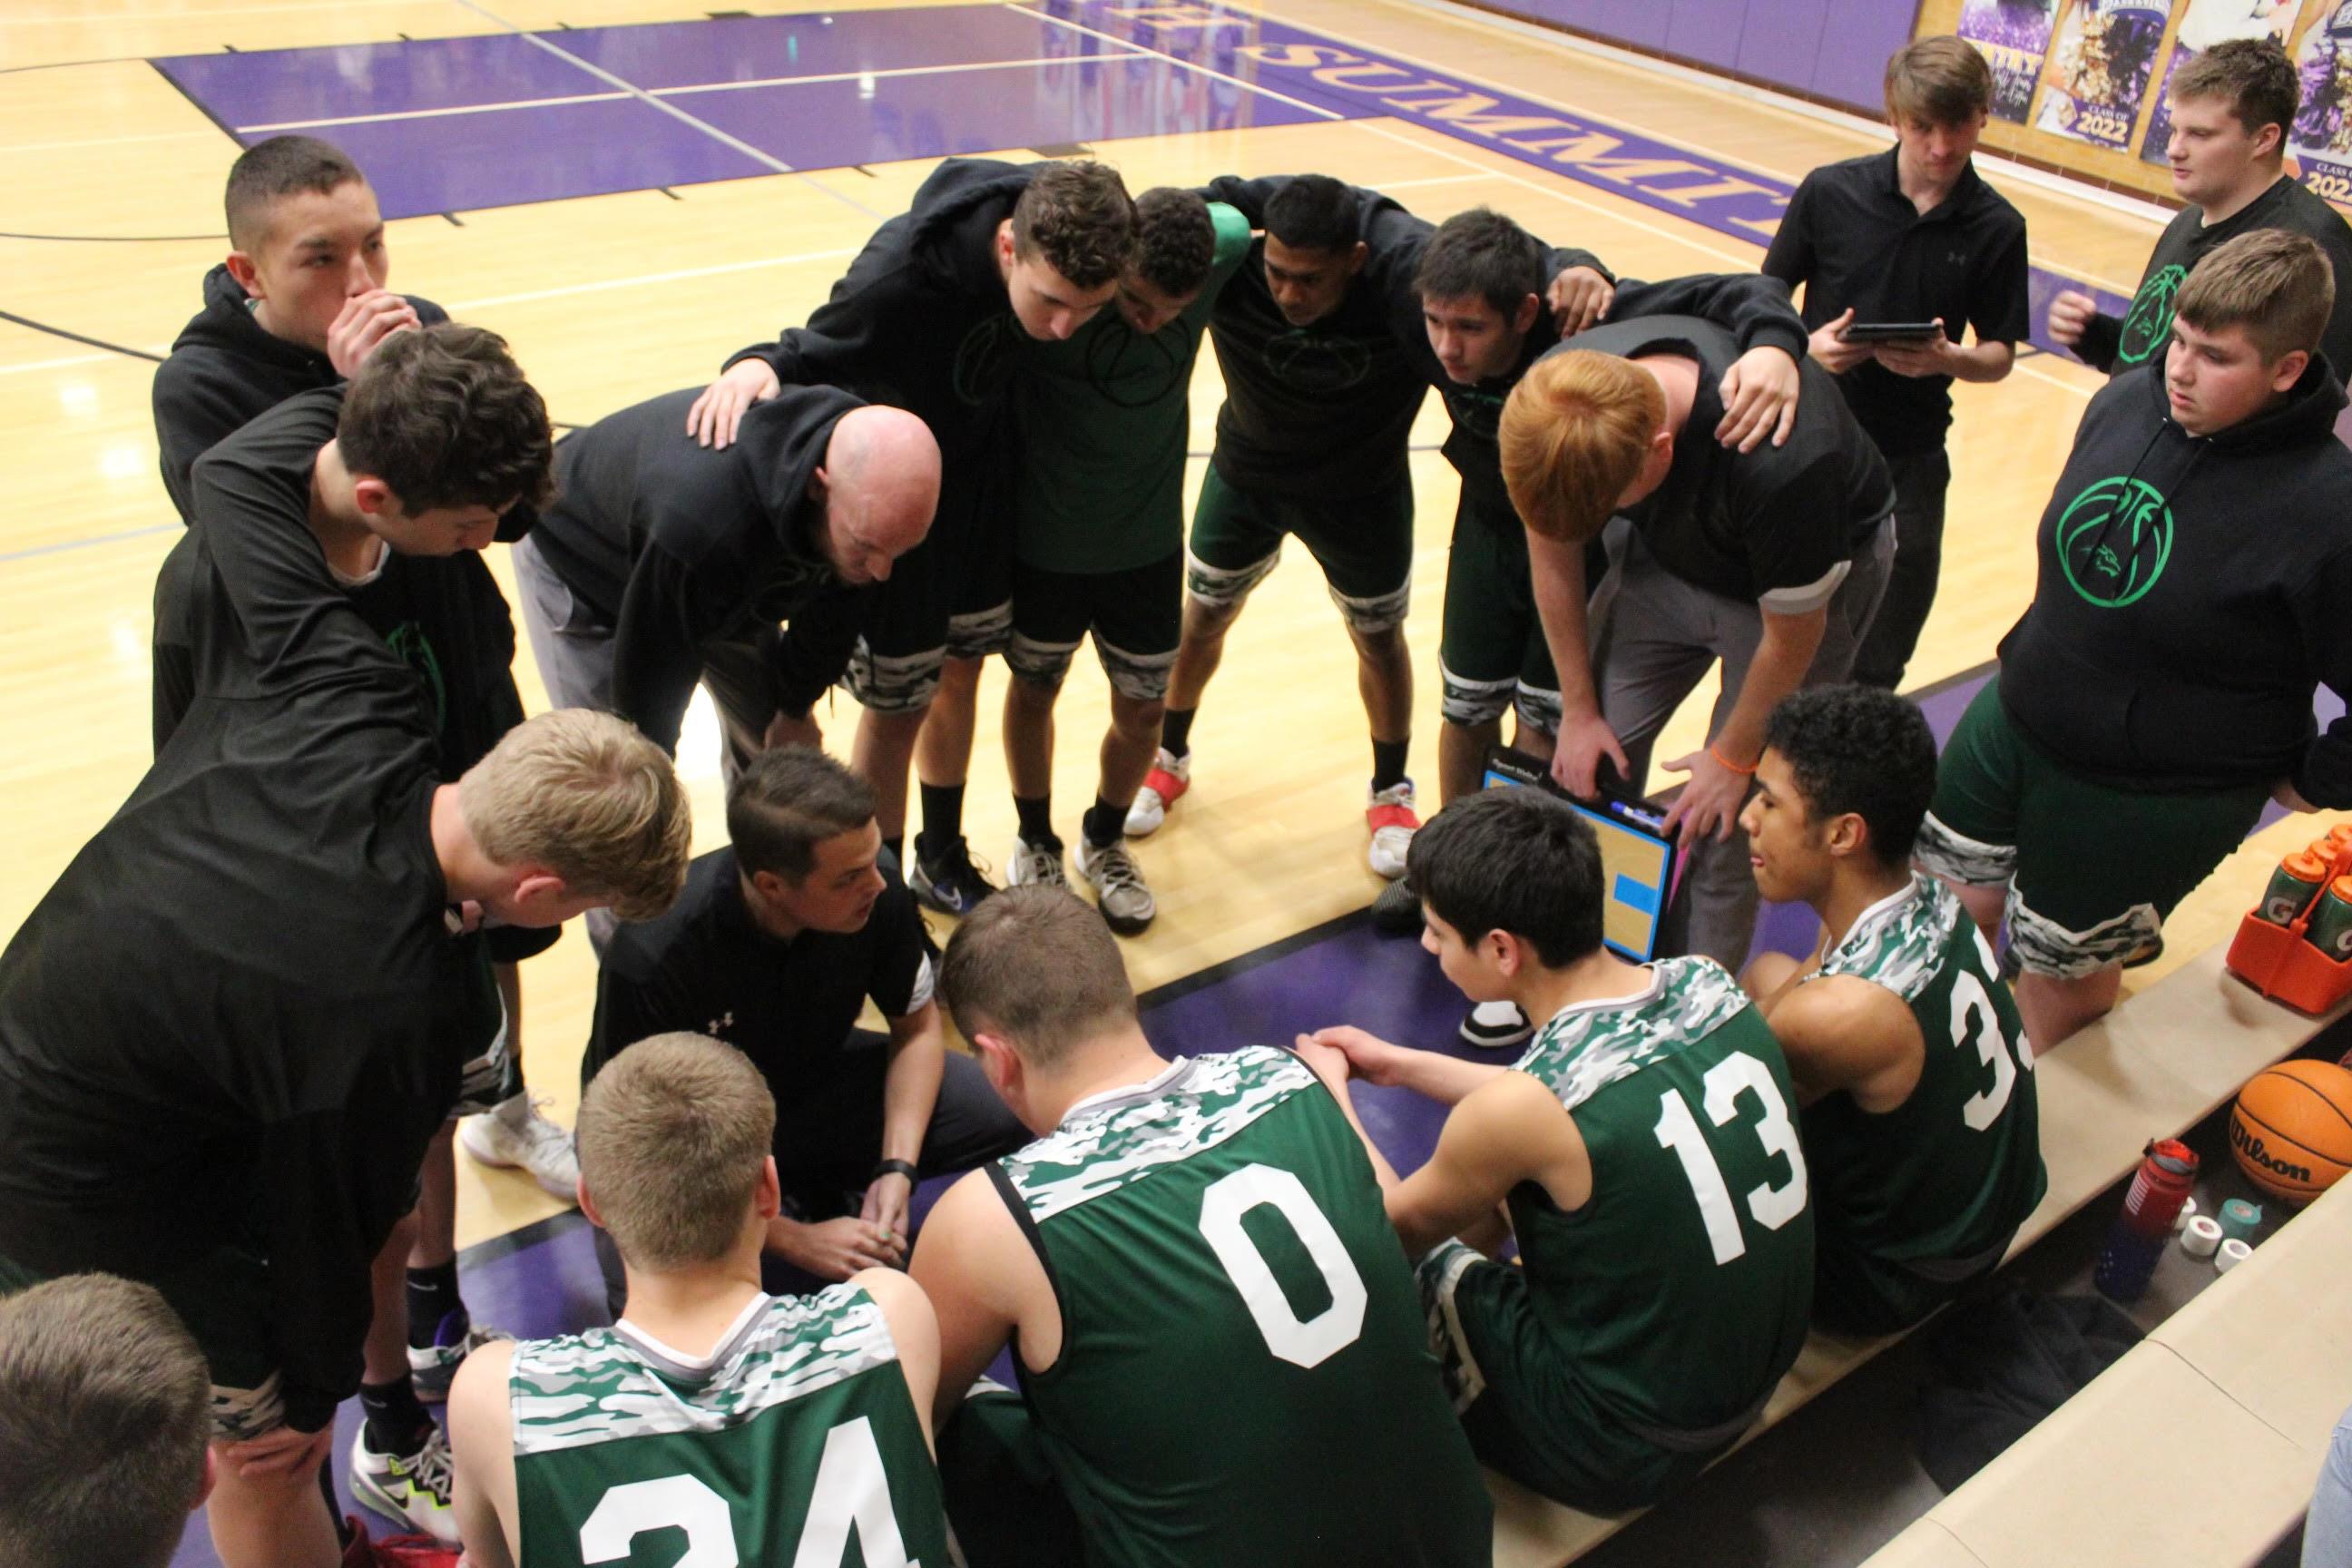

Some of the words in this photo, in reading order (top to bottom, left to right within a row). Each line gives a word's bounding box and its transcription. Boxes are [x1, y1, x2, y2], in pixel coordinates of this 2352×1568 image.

[2076, 111, 2129, 143] 2022
[2316, 162, 2347, 178] CLASS
[2268, 897, 2297, 925] G
[1653, 1051, 1808, 1266] 13
[2230, 1115, 2310, 1182] Wilson
[1199, 1163, 1368, 1369] 0
